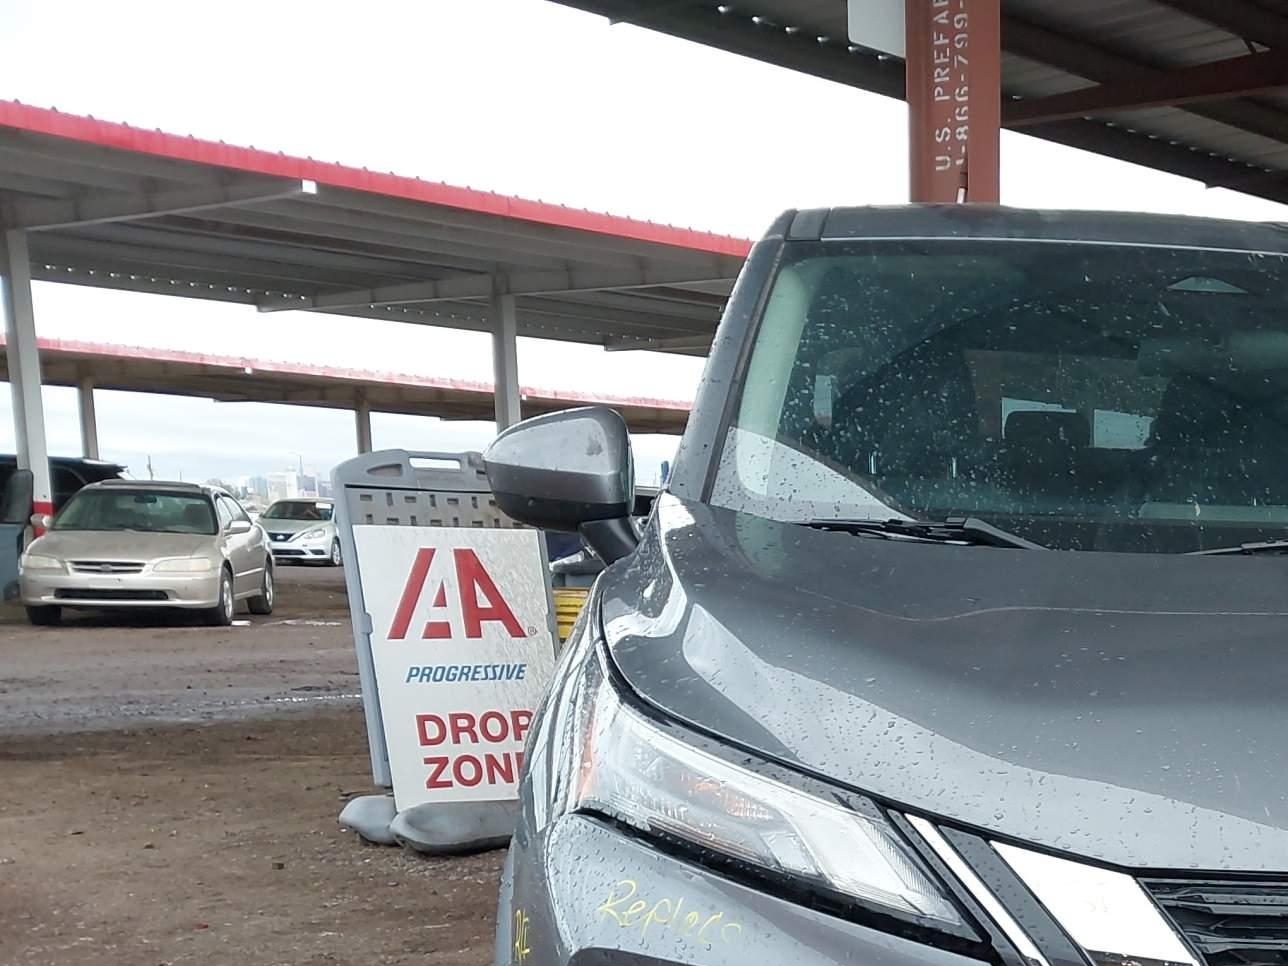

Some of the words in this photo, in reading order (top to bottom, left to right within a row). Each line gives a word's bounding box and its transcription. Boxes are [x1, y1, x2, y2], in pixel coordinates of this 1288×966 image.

[933, 0, 950, 101] PREFA
[406, 663, 528, 684] PROGRESSIVE
[416, 710, 534, 747] DROP
